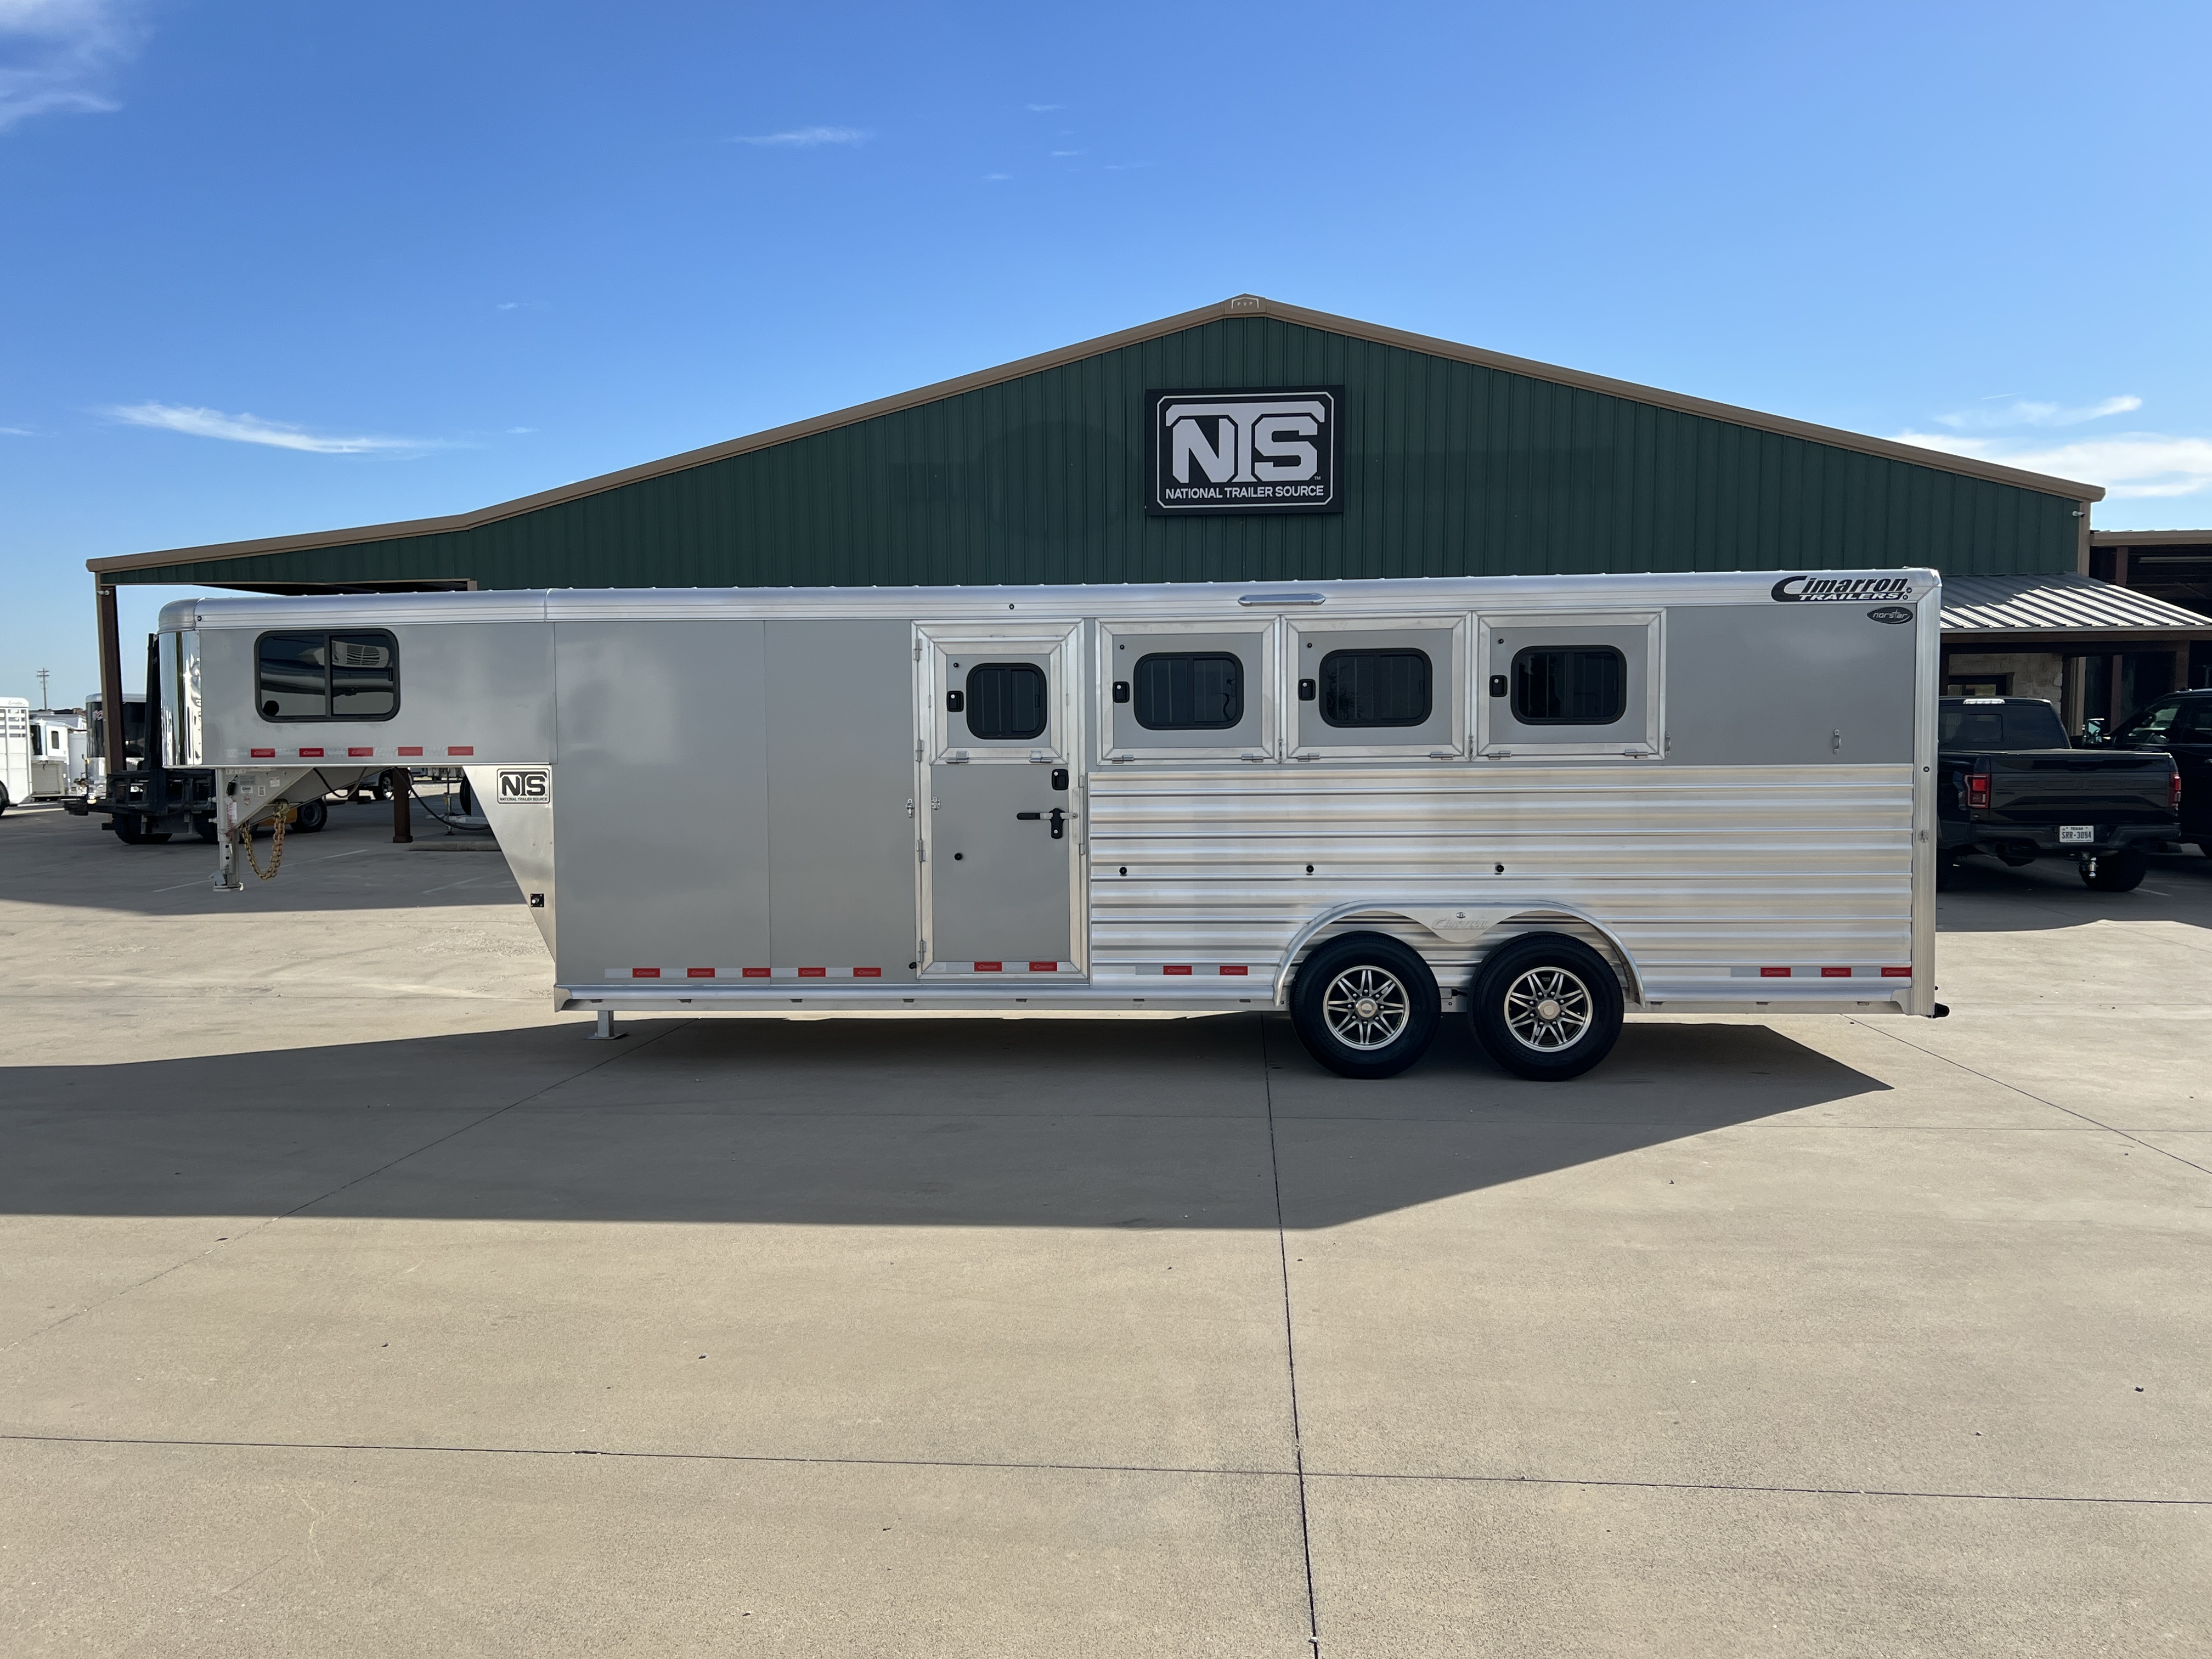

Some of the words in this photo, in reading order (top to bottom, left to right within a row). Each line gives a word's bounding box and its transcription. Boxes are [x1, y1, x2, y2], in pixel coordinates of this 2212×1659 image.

[1166, 400, 1325, 483] NTS
[1166, 488, 1223, 499] NATIONAL
[1224, 486, 1273, 498] TRAILER
[1275, 485, 1324, 497] SOURCE
[1771, 575, 1908, 602] Cimarron
[1872, 609, 1908, 619] norstar
[500, 771, 547, 795] NTS
